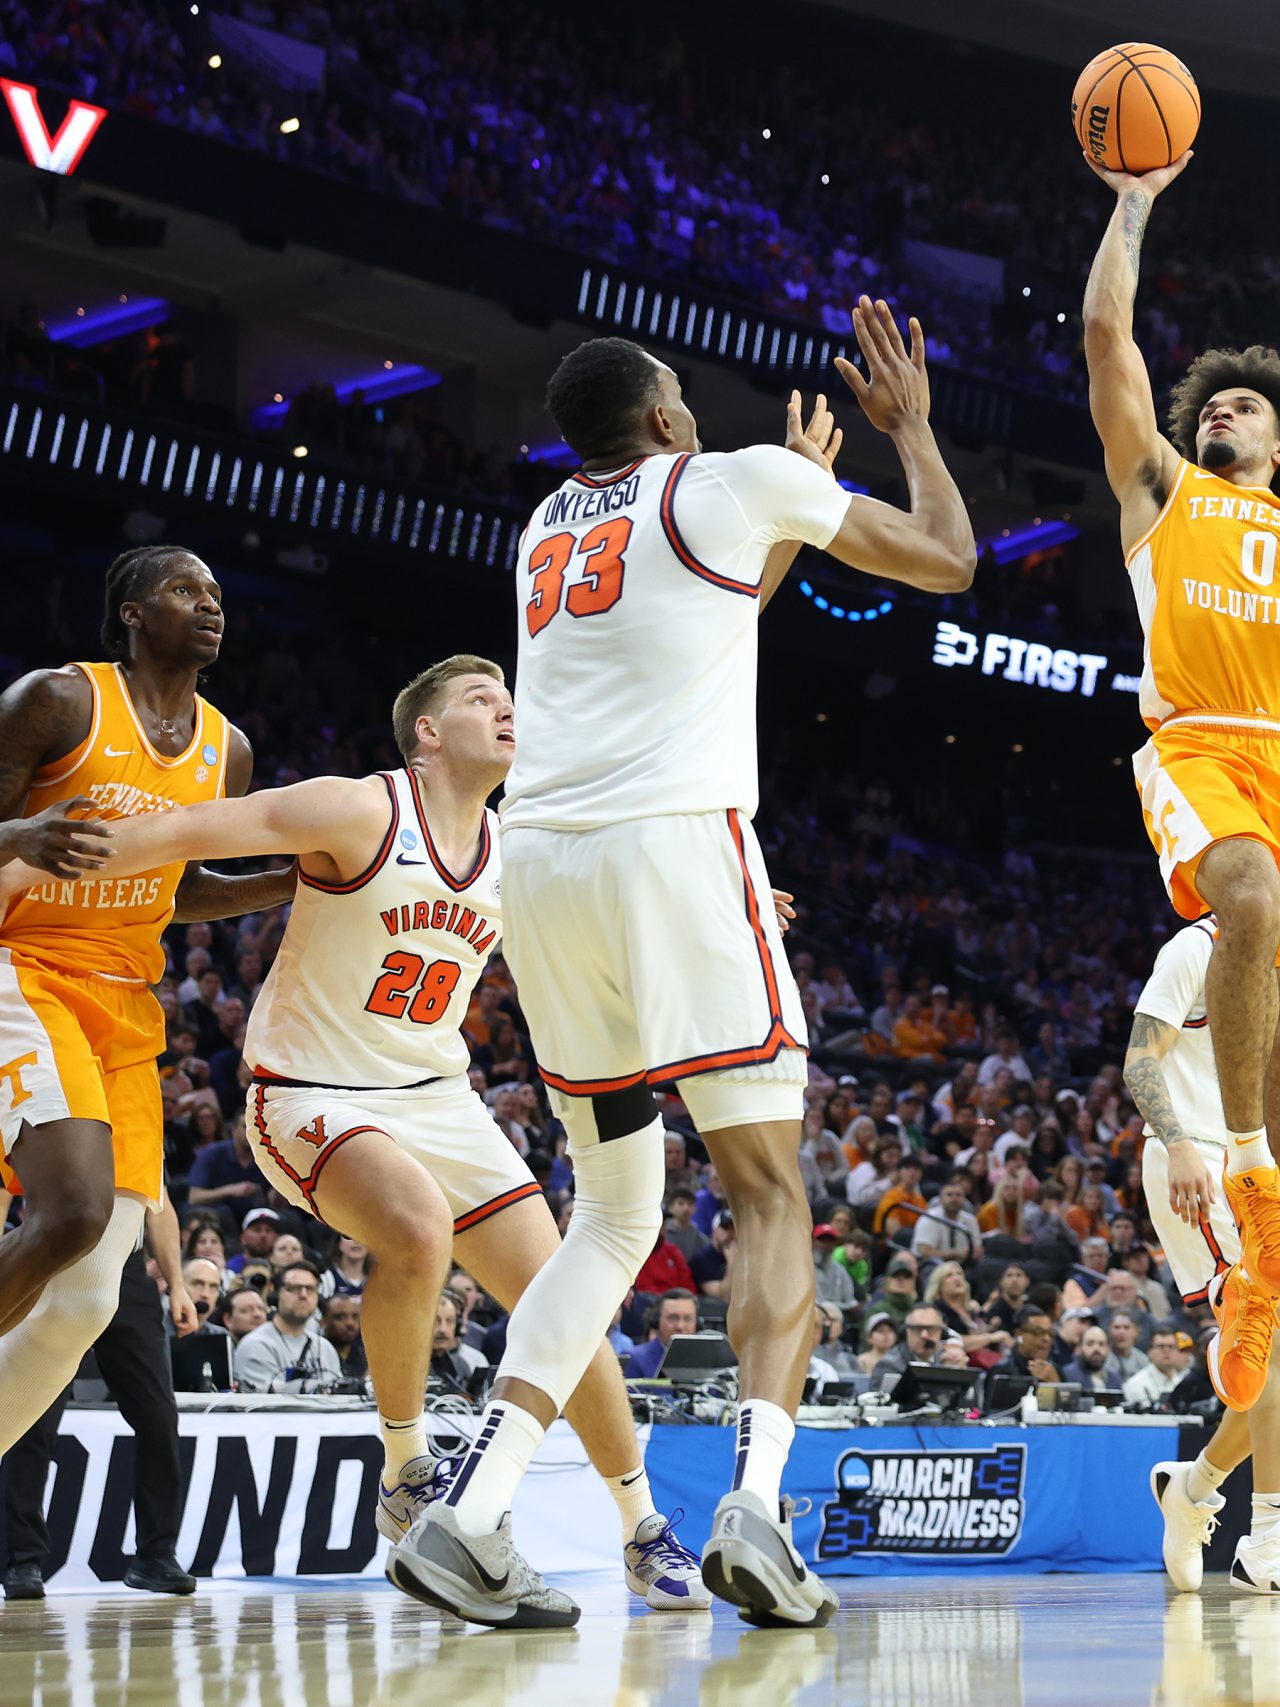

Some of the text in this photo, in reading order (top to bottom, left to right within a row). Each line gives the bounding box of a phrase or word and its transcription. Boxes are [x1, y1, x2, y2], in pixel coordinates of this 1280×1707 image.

[1088, 105, 1110, 168] Wilso
[543, 475, 640, 527] ONYENSO
[526, 515, 634, 640] 33
[1241, 530, 1278, 587] 0
[981, 633, 1108, 698] FIRST
[380, 900, 497, 955] VIRGINIA
[364, 950, 461, 1025] 28
[868, 1458, 975, 1498] MARCH
[877, 1498, 1021, 1539] MADNESS
